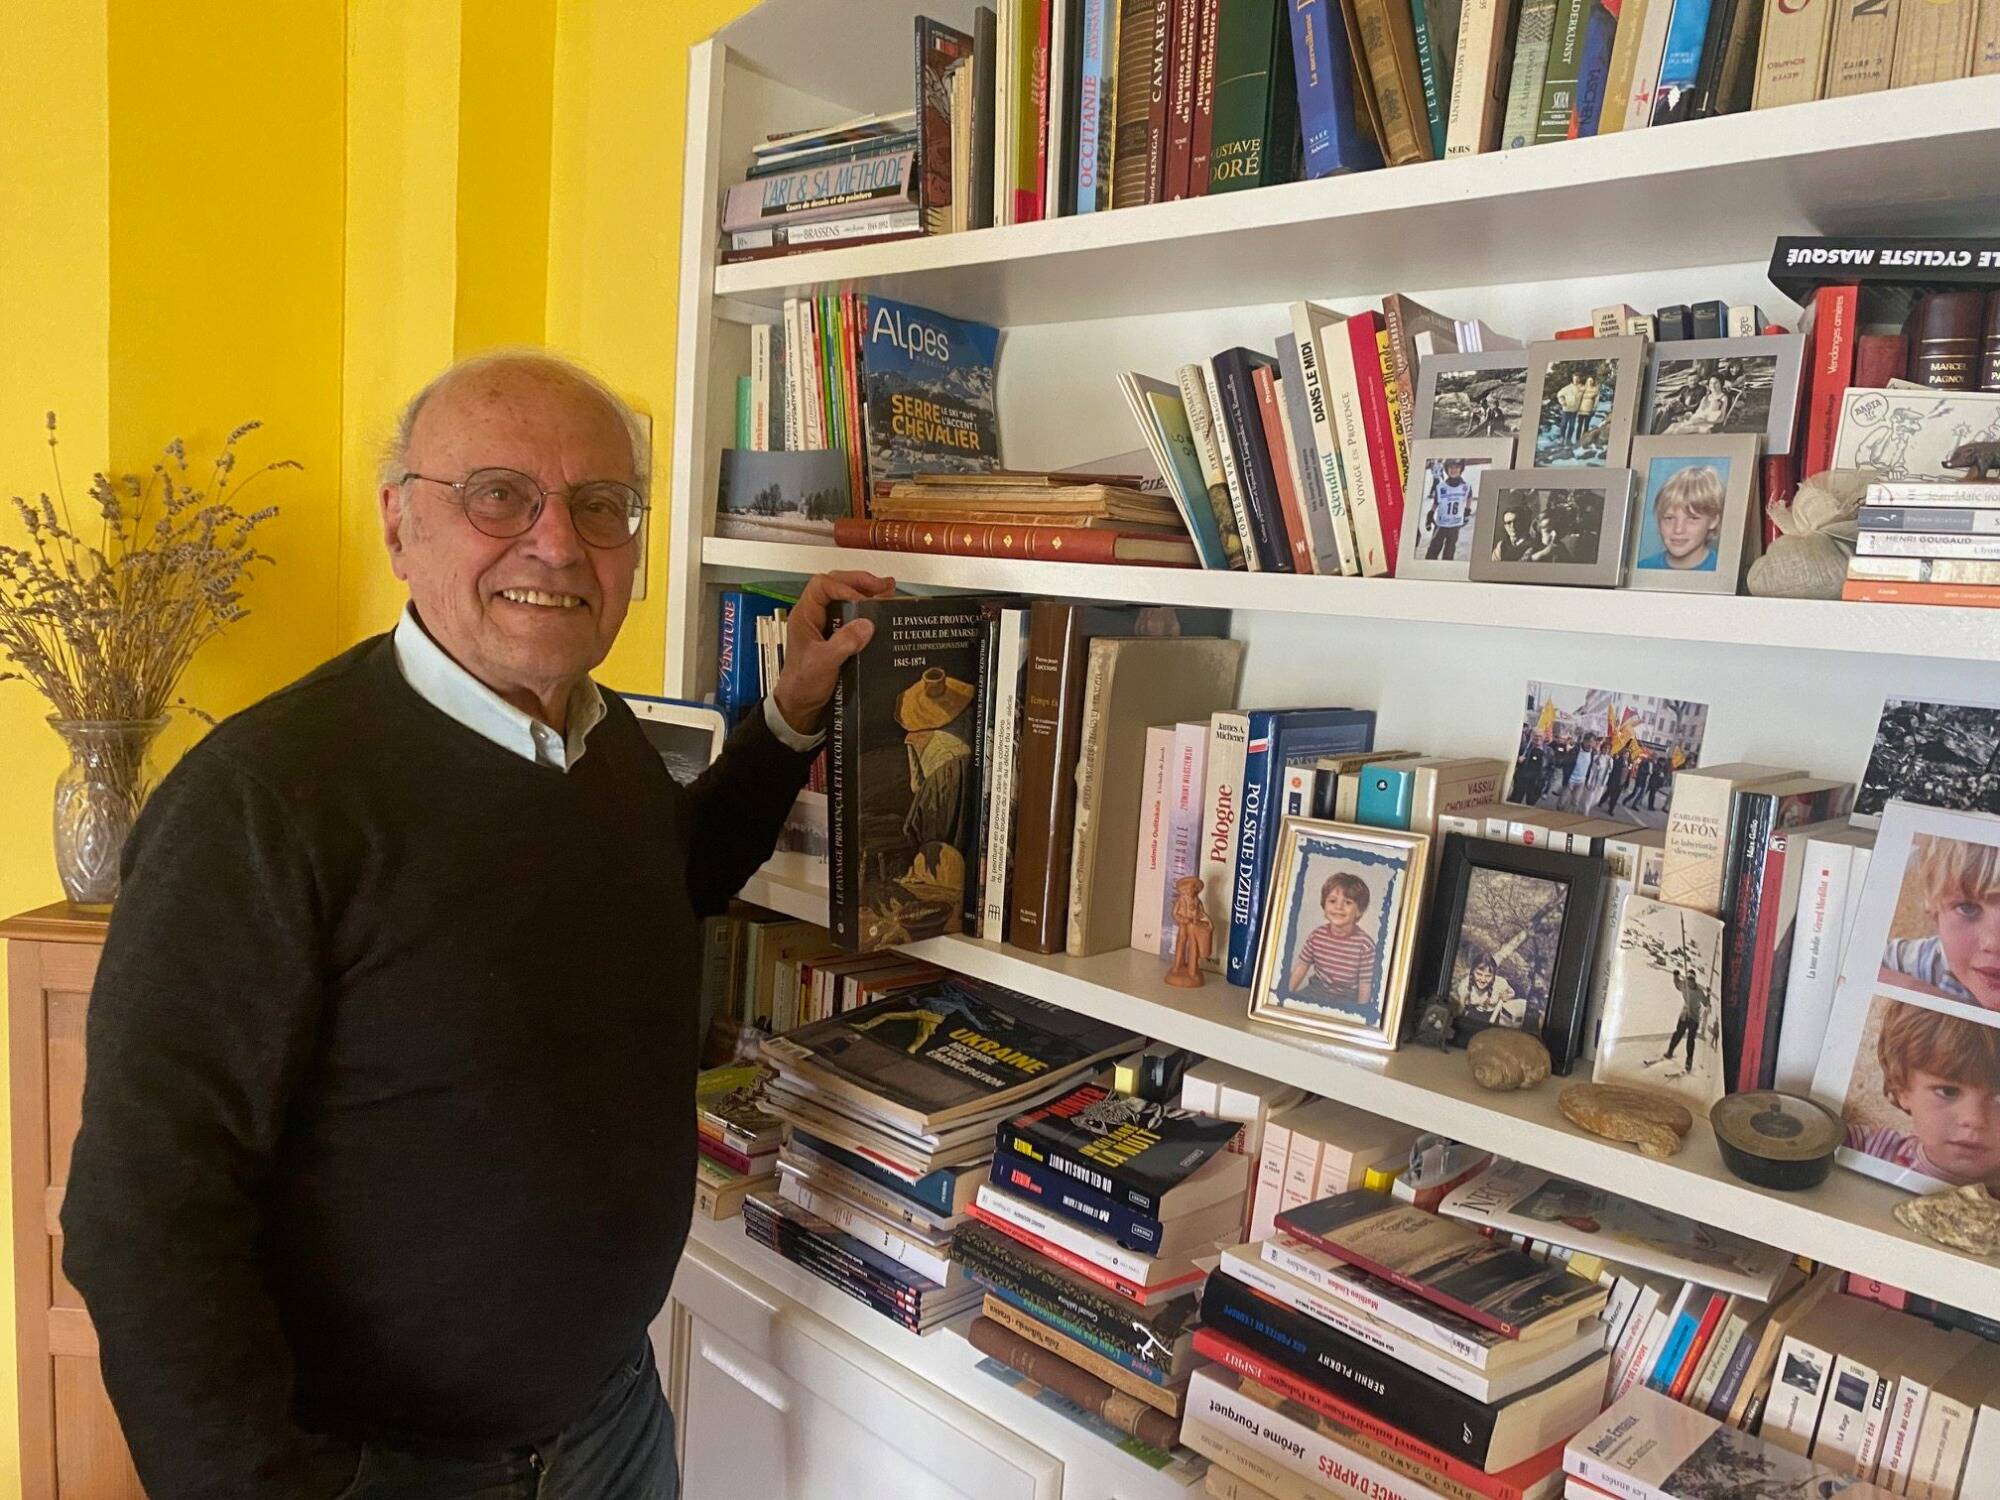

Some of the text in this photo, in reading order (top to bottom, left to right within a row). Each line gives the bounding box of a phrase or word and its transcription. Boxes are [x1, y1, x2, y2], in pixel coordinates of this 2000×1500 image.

[1153, 1, 1167, 103] CAMARES
[1201, 38, 1208, 53] et
[1207, 13, 1217, 83] littérature
[1176, 48, 1186, 115] Histoire et
[1182, 21, 1195, 124] de la littérature
[1197, 57, 1206, 107] Histoire
[1416, 23, 1439, 125] L'ERMITAGE
[1451, 54, 1466, 124] MOUVEMENTS
[1202, 101, 1210, 115] de
[1206, 85, 1212, 99] la
[1080, 75, 1097, 188] OCCITANIE
[1151, 128, 1160, 173] SENEGAS
[761, 175, 798, 208] L'ART
[797, 174, 809, 200] &
[813, 169, 830, 199] SA
[786, 201, 801, 212] Cours
[802, 198, 810, 209] de
[1786, 247, 1876, 266] MASQUÉ
[1879, 249, 1972, 267] CYCLISTE
[872, 307, 949, 361] Alpes
[1825, 328, 1843, 374] Vendanges
[1376, 342, 1396, 385] Monde
[1298, 340, 1326, 423] DANS LE MIDI
[891, 394, 942, 424] SERRE
[1390, 409, 1404, 436] avec
[892, 416, 981, 450] CHEVALIER
[1221, 453, 1235, 476] VAR
[1321, 452, 1346, 518] Stendhal
[1231, 495, 1249, 538] CONTES
[1886, 535, 1972, 546] HENRI GOUGAUD
[893, 616, 904, 626] LE
[904, 616, 939, 626] PAYSAGE
[893, 629, 950, 641] ET L'ECOLE DE
[719, 600, 736, 692] PEINTURE
[893, 656, 927, 668] 1845-1874
[833, 717, 843, 730] DE
[1215, 730, 1246, 743] Michener
[1217, 723, 1238, 734] James
[833, 731, 843, 774] L'ECOLE
[834, 775, 843, 787] ET
[834, 789, 844, 849] PROVENÇAL
[994, 795, 1002, 829] provence
[1210, 783, 1233, 864] Pologne
[1671, 819, 1718, 839] ZAFÓN
[993, 830, 999, 840] en
[998, 833, 1005, 844] de
[1746, 818, 1759, 859] Max Gallo
[835, 850, 844, 891] PAYSAGE
[991, 841, 999, 874] peinture
[1235, 783, 1261, 925] POLSKIE DZIEJE
[996, 873, 1002, 883] du
[948, 1027, 1049, 1075] UKRAINE
[1093, 1128, 1163, 1168] LA NUIT
[1049, 1154, 1113, 1194] UN DANS LA NUIT
[1099, 1210, 1110, 1223] M
[1222, 1353, 1262, 1379] ESPRIT
[1317, 1353, 1384, 1395] SERHII PLOKHY
[1873, 1379, 1887, 1409] POINTS
[1208, 1400, 1259, 1435] Fourquet
[1263, 1428, 1306, 1459] Jérôme
[1587, 1415, 1640, 1457] Annie Ernaux
[1836, 1429, 1844, 1441] La
[1318, 1454, 1370, 1493] D'APRÈS
[1380, 1450, 1421, 1475] DAWNO
[1616, 1453, 1638, 1471] Les
[1601, 1473, 1649, 1500] Les années
